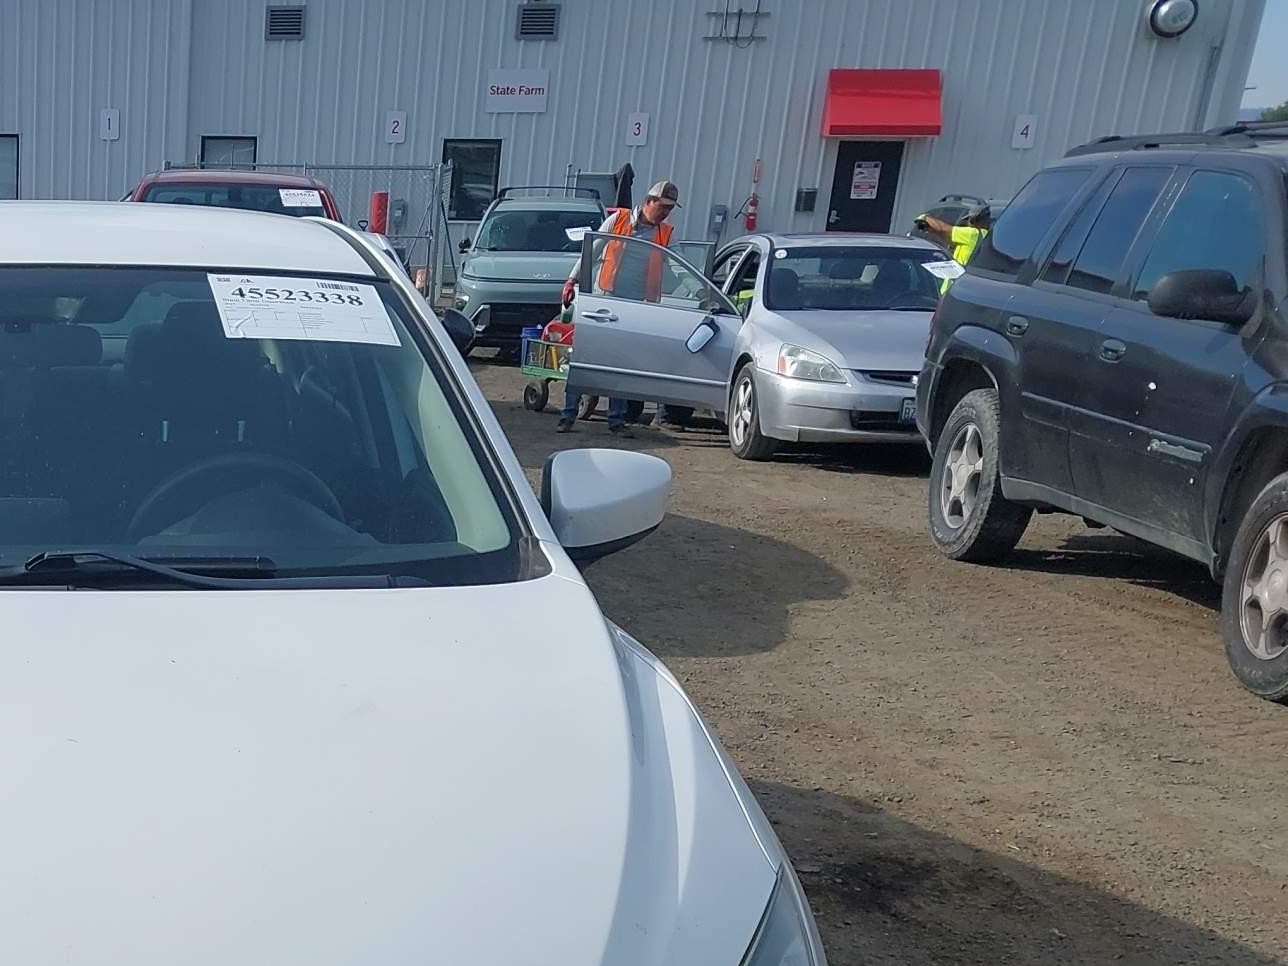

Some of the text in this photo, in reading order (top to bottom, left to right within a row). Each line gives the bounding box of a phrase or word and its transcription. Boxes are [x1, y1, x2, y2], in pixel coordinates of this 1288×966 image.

[489, 85, 545, 96] State Farm
[107, 117, 111, 131] 1
[392, 120, 400, 134] 2
[633, 121, 641, 136] 3
[1020, 124, 1030, 140] 4
[231, 287, 363, 307] 45523338
